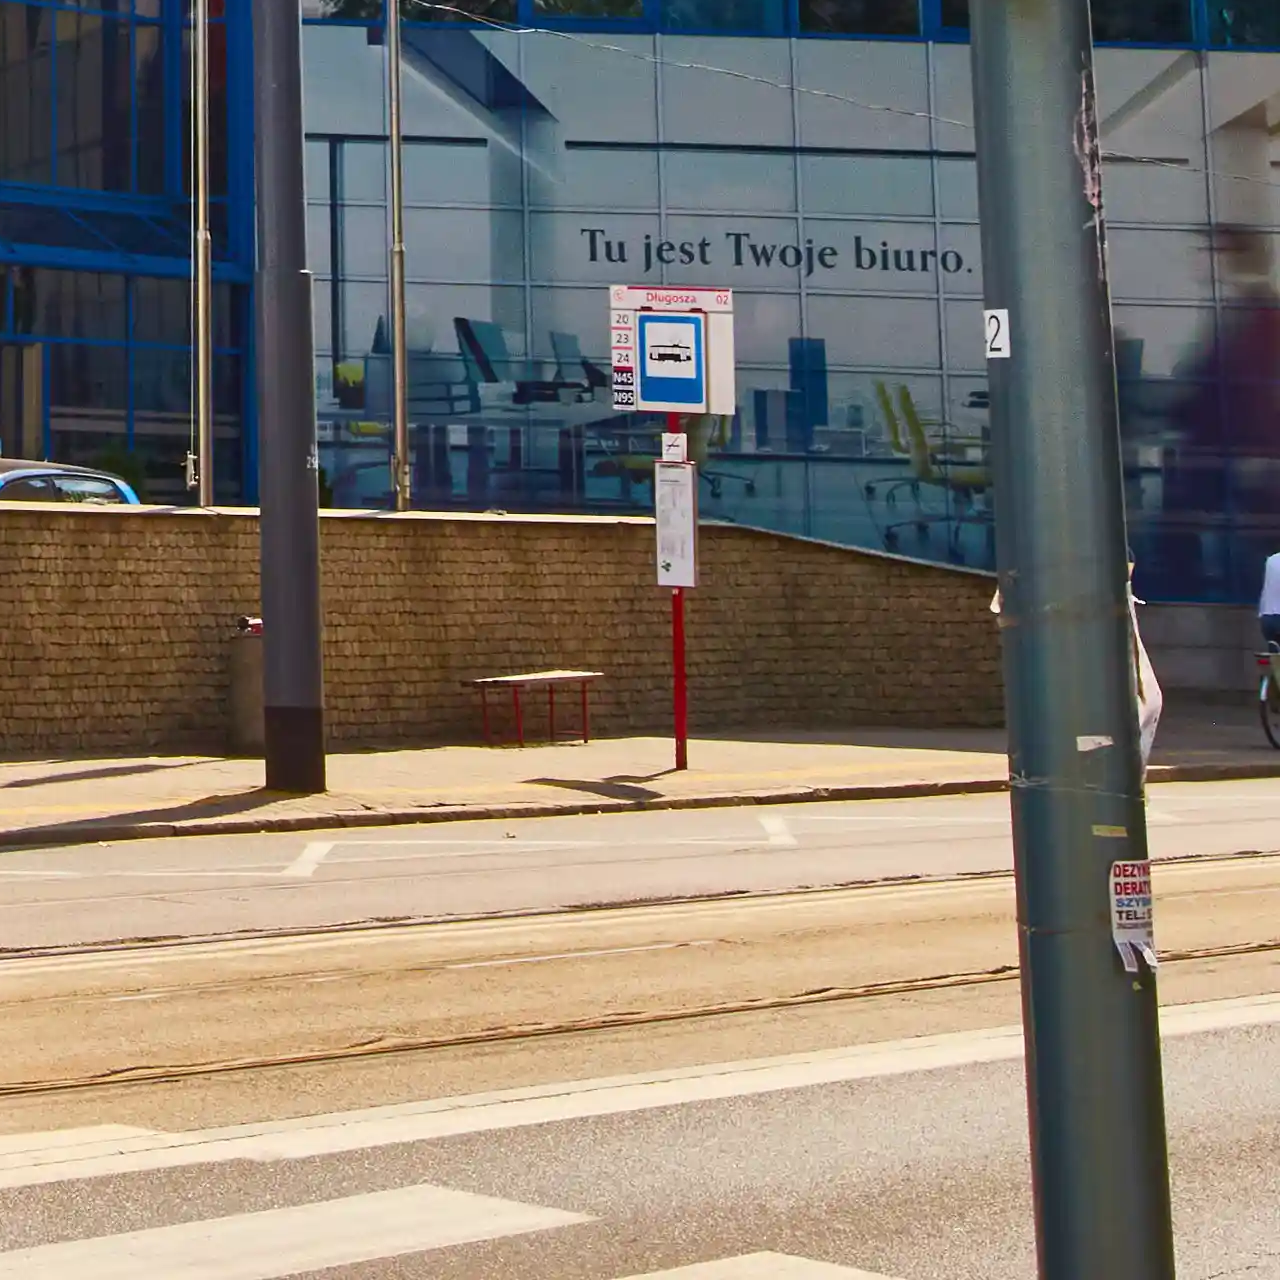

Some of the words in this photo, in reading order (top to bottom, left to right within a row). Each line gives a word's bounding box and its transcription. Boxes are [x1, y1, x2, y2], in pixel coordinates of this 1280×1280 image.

[580, 228, 628, 263] Tu
[643, 234, 712, 273] jest
[725, 232, 839, 277] Twoje
[854, 235, 973, 274] biuro.
[646, 292, 697, 305] Długosza
[715, 294, 729, 305] 02
[616, 313, 629, 324] 20
[616, 333, 629, 344] 23
[988, 314, 1002, 352] 2
[616, 352, 630, 364] 24
[614, 371, 633, 384] N45
[613, 392, 634, 404] N95
[1113, 863, 1151, 878] DEZYN
